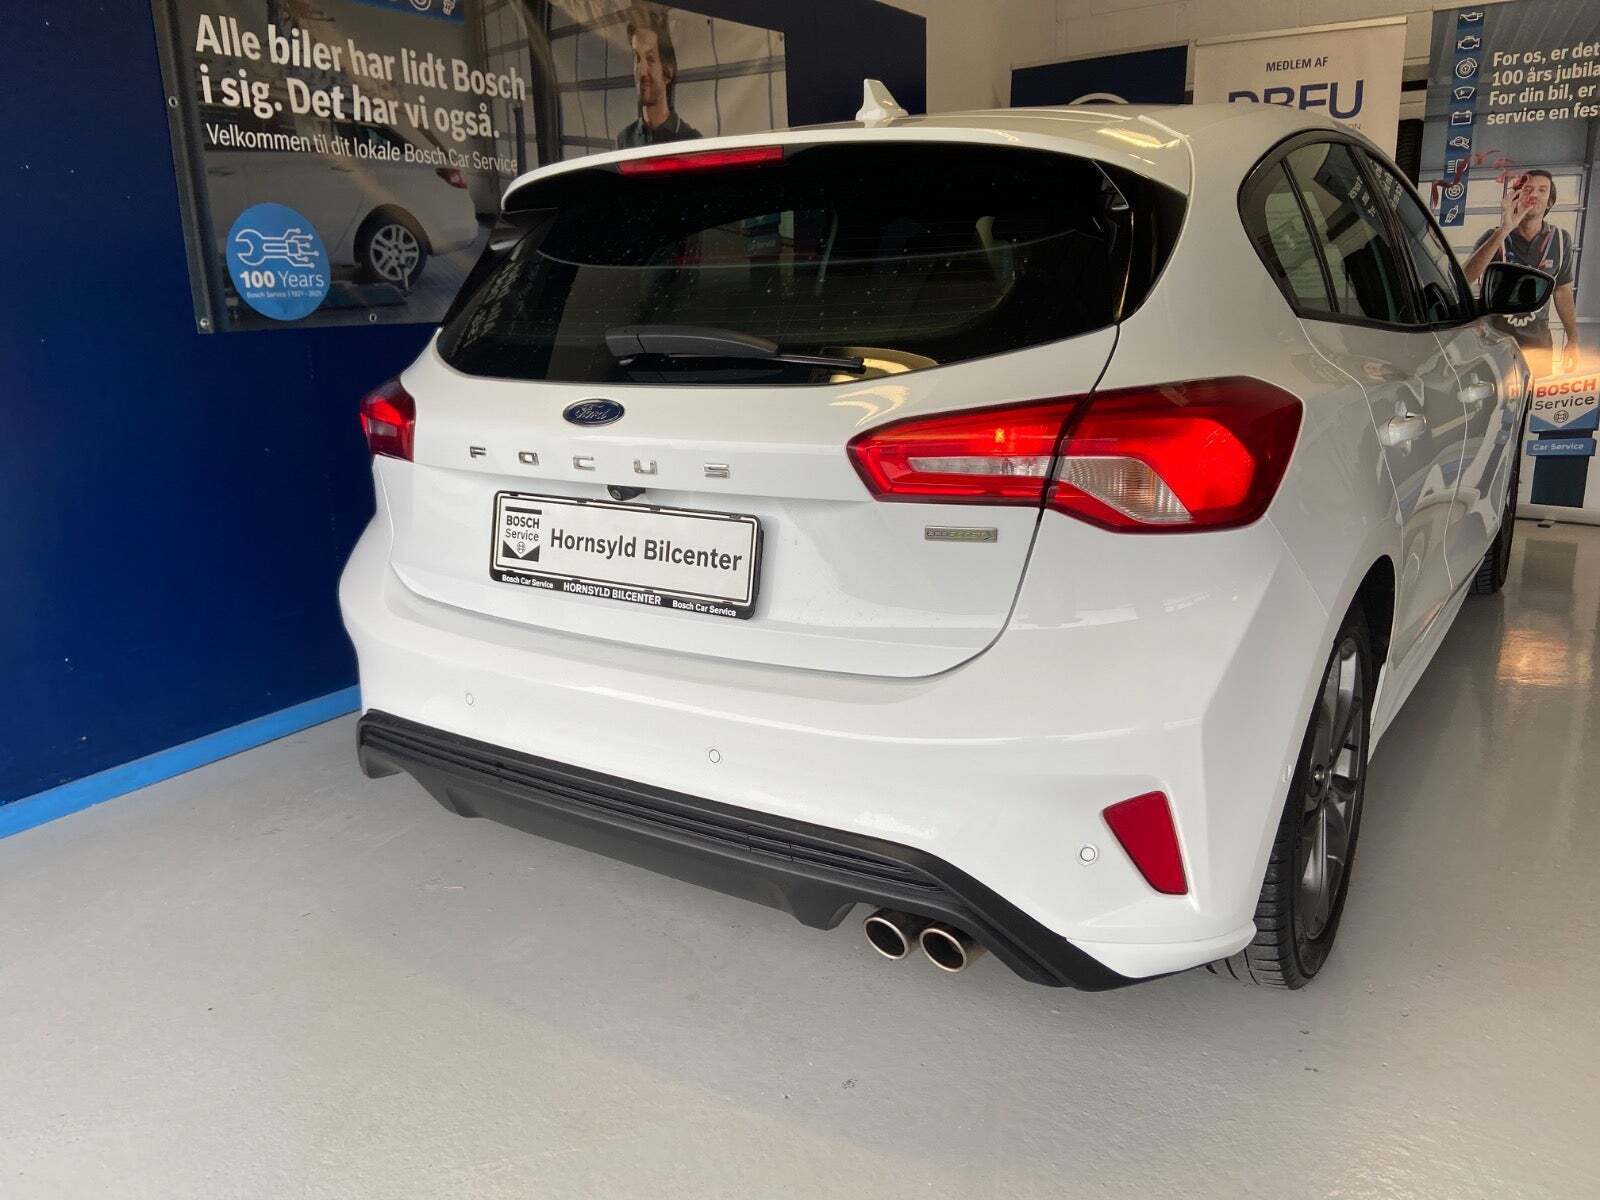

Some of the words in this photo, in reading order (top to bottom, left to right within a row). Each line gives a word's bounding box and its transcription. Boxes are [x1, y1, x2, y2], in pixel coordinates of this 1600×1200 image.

[196, 14, 261, 60] Alle
[268, 24, 342, 71] biler
[347, 38, 395, 80] har
[401, 48, 448, 90] lidt
[452, 58, 525, 100] Bosch
[1265, 58, 1312, 72] MEDLEM
[1314, 56, 1329, 68] AF
[1493, 52, 1520, 67] For
[1523, 50, 1546, 64] os,
[1551, 47, 1569, 61] er
[1572, 42, 1600, 58] det
[1492, 69, 1524, 87] 100
[1527, 66, 1553, 83] års
[200, 63, 213, 104] i
[220, 68, 282, 119] sig.
[286, 77, 346, 119] Det
[352, 84, 399, 125] har
[404, 95, 429, 129] vi
[434, 102, 499, 142] også.
[1489, 91, 1516, 106] For
[1519, 87, 1545, 103] din
[1548, 83, 1574, 101] bil,
[1578, 84, 1597, 98] er
[1486, 107, 1546, 125] service
[1549, 107, 1570, 120] en
[1573, 102, 1600, 118] fes
[206, 123, 311, 152] Velkommen
[314, 133, 329, 154] til
[331, 135, 352, 157] dit
[353, 137, 400, 161] lokale
[405, 143, 447, 166] Bosch
[450, 149, 470, 169] Car
[473, 151, 518, 172] Service
[240, 270, 276, 289] 100
[278, 270, 325, 288] Years
[1535, 378, 1597, 398] BOSCH
[1534, 395, 1595, 411] Service
[1532, 443, 1550, 451] Car
[1550, 442, 1584, 451] Service
[470, 446, 730, 479] FOCUS
[506, 514, 540, 530] BOSCH
[505, 528, 540, 541] Service
[551, 528, 637, 560] Hornsyld
[644, 539, 743, 571] Bilcenter
[502, 574, 520, 584] Bosch
[520, 577, 531, 585] Car
[532, 579, 554, 589] Service
[563, 582, 611, 598] HORNSYLD
[611, 589, 661, 606] BILCENTER
[672, 599, 694, 611] Bosch
[695, 603, 708, 613] Car
[709, 605, 737, 617] Service
